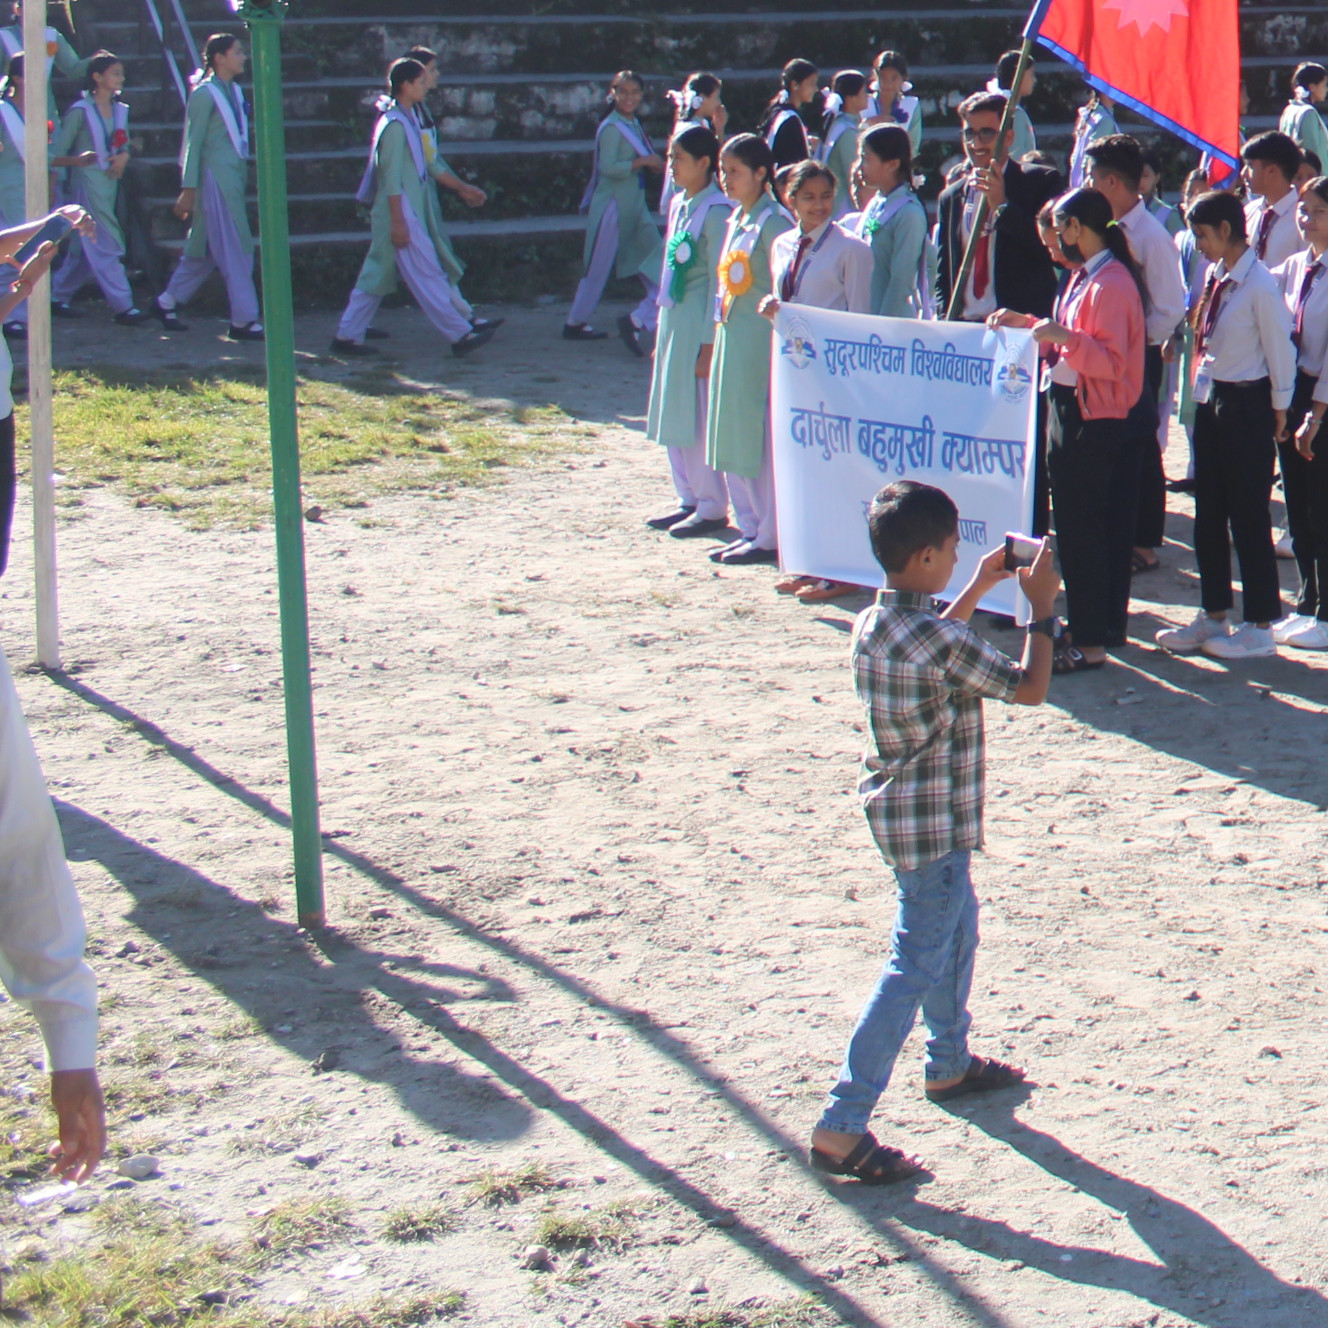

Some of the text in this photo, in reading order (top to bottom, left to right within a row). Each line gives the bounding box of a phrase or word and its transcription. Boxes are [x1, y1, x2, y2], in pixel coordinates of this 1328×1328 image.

[824, 333, 996, 387] सुदूरपश्चिम विश्वविद्यालय
[790, 401, 852, 462] दार्चुला
[858, 415, 936, 476] बहुमुखी
[958, 518, 987, 546] पाल
